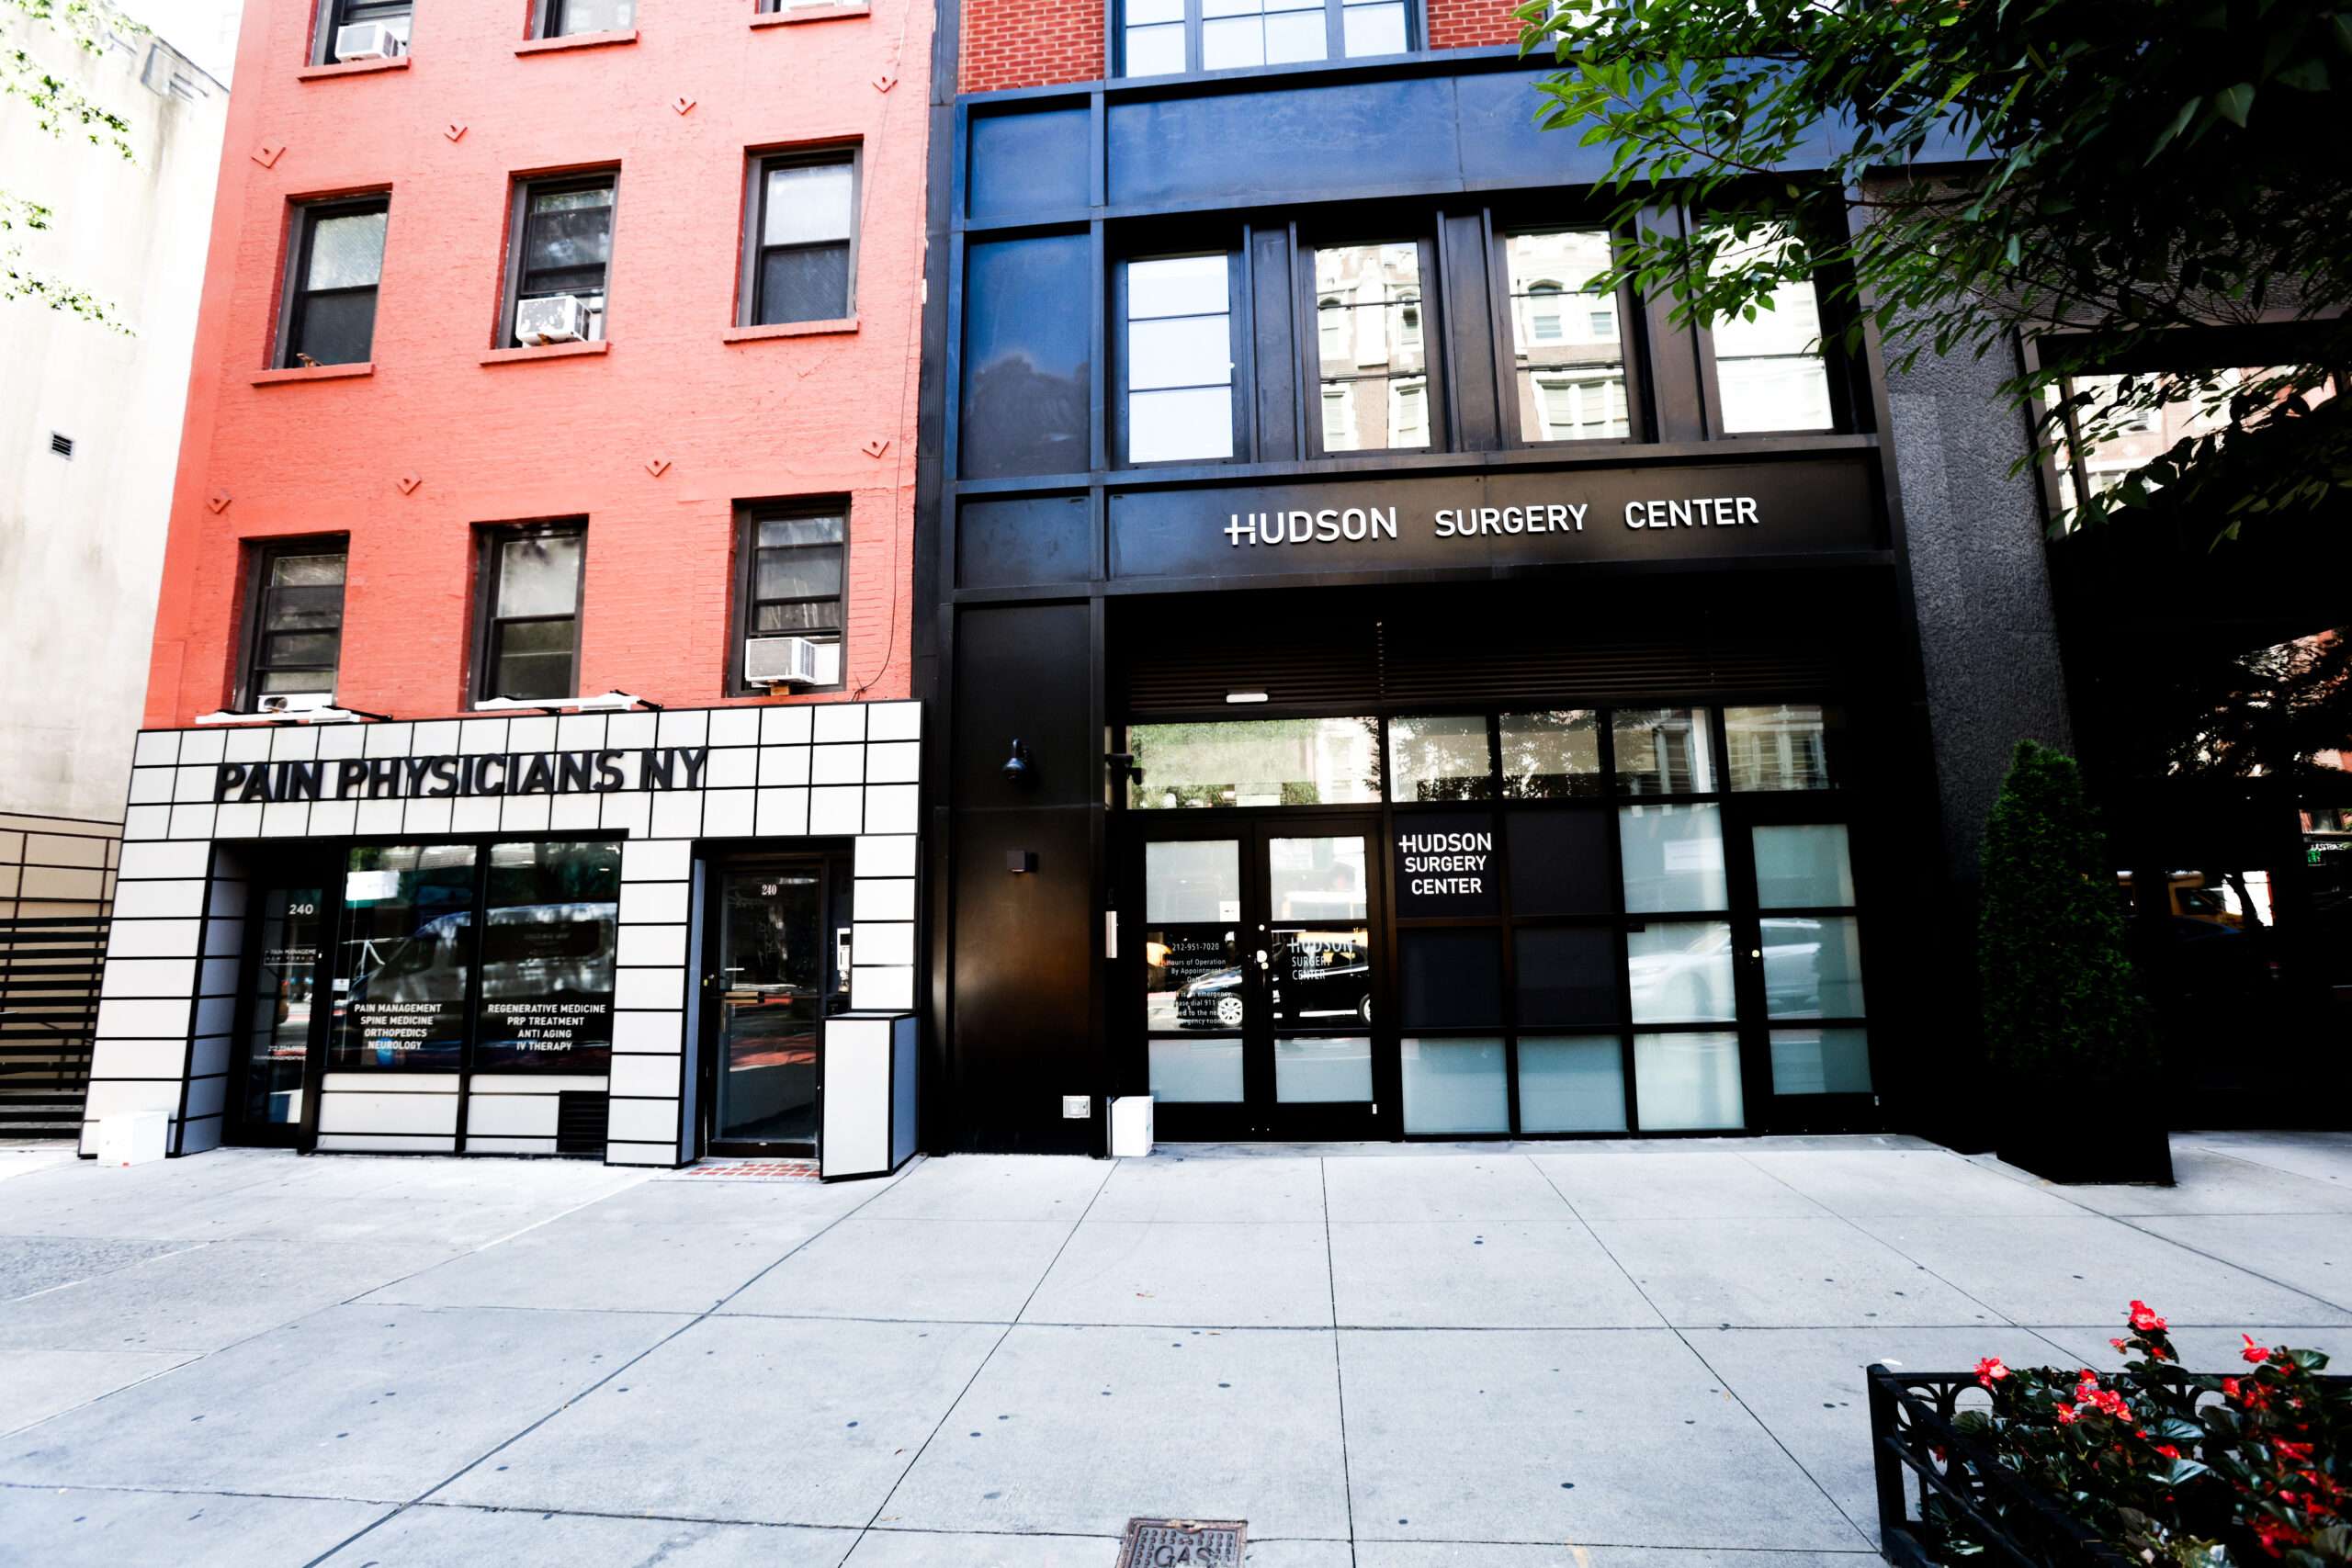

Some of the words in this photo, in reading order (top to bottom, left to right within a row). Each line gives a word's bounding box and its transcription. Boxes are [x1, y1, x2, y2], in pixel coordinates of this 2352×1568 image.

[1224, 507, 1397, 545] HUDSON
[1435, 504, 1588, 537] SURGERY
[1624, 497, 1759, 529] CENTER
[213, 761, 323, 803] PAIN
[336, 749, 625, 801] PHYSICIANS
[639, 746, 707, 792] NY
[1398, 832, 1492, 853] HUDSON
[1405, 855, 1487, 873] SURGERY
[762, 884, 777, 896] 240
[1411, 877, 1482, 895] CENTER
[288, 904, 314, 915] 240
[1172, 942, 1220, 952] 212-951-7020
[1287, 935, 1352, 953] HUDSON
[1194, 958, 1227, 966] Operation
[1292, 969, 1326, 980] CENTER
[354, 1004, 376, 1012] PAIN
[378, 1003, 442, 1012] MANAGEMENT
[487, 1004, 558, 1013] REGENERATIVE
[560, 1004, 606, 1013] MEDICINE
[360, 1016, 388, 1025] SPINE
[390, 1016, 434, 1025] MEDICINE
[507, 1017, 526, 1025] PRP
[528, 1017, 585, 1025] TREATMENT
[364, 1028, 427, 1037] ORTHOPEDICS
[517, 1029, 540, 1038] ANTI
[542, 1029, 572, 1038] AGING
[368, 1041, 423, 1050] NEUROLOGY
[516, 1042, 526, 1051] IV
[528, 1042, 572, 1051] THERAPY
[1154, 1545, 1212, 1567] GAS
